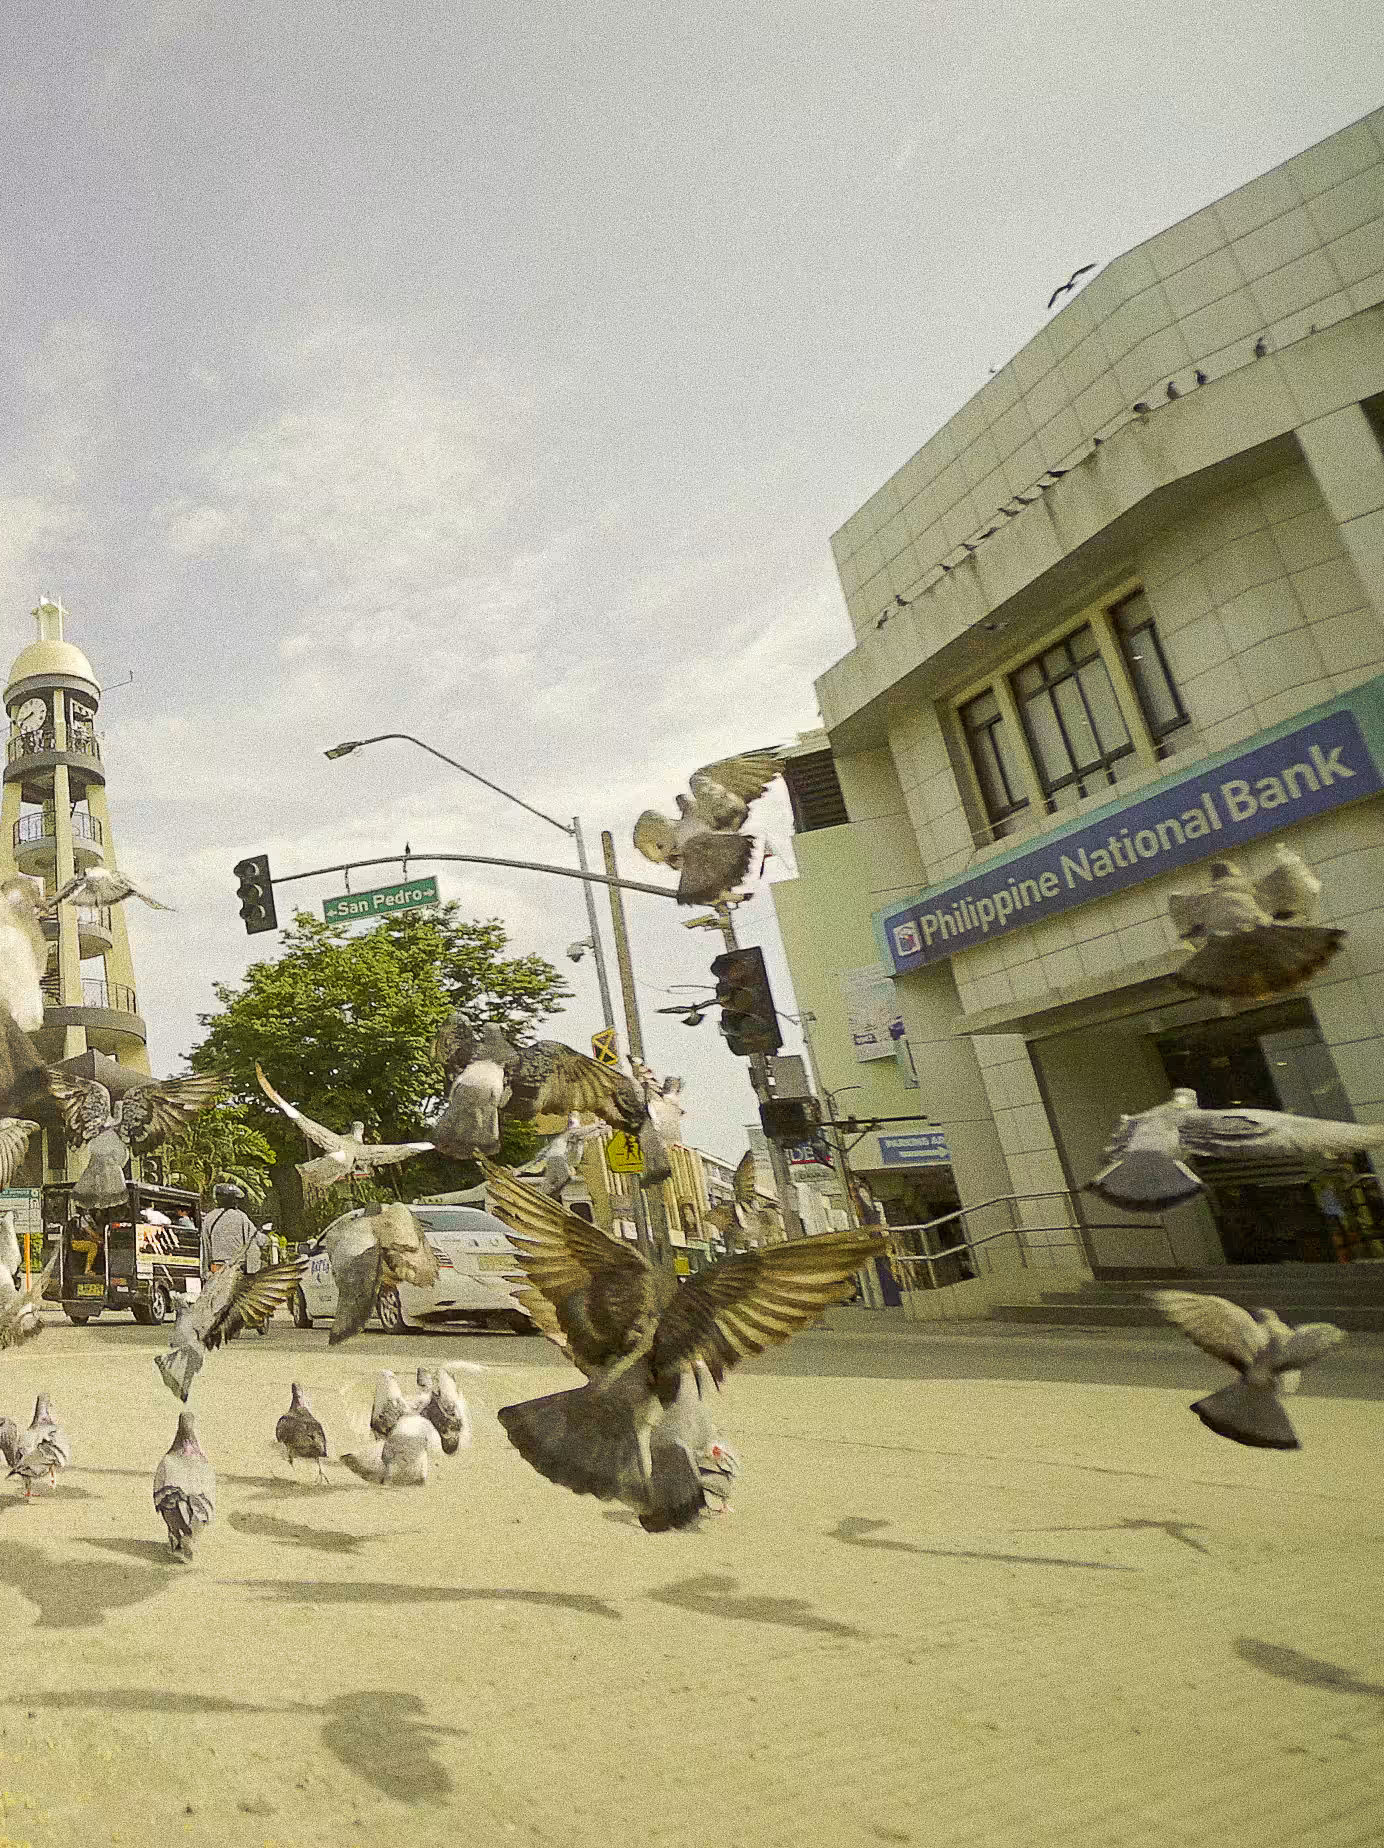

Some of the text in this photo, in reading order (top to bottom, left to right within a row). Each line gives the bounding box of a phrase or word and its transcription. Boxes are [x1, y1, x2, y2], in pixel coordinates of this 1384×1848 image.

[920, 744, 1357, 945] Philippine National Bank
[337, 889, 423, 916] San Pedro
